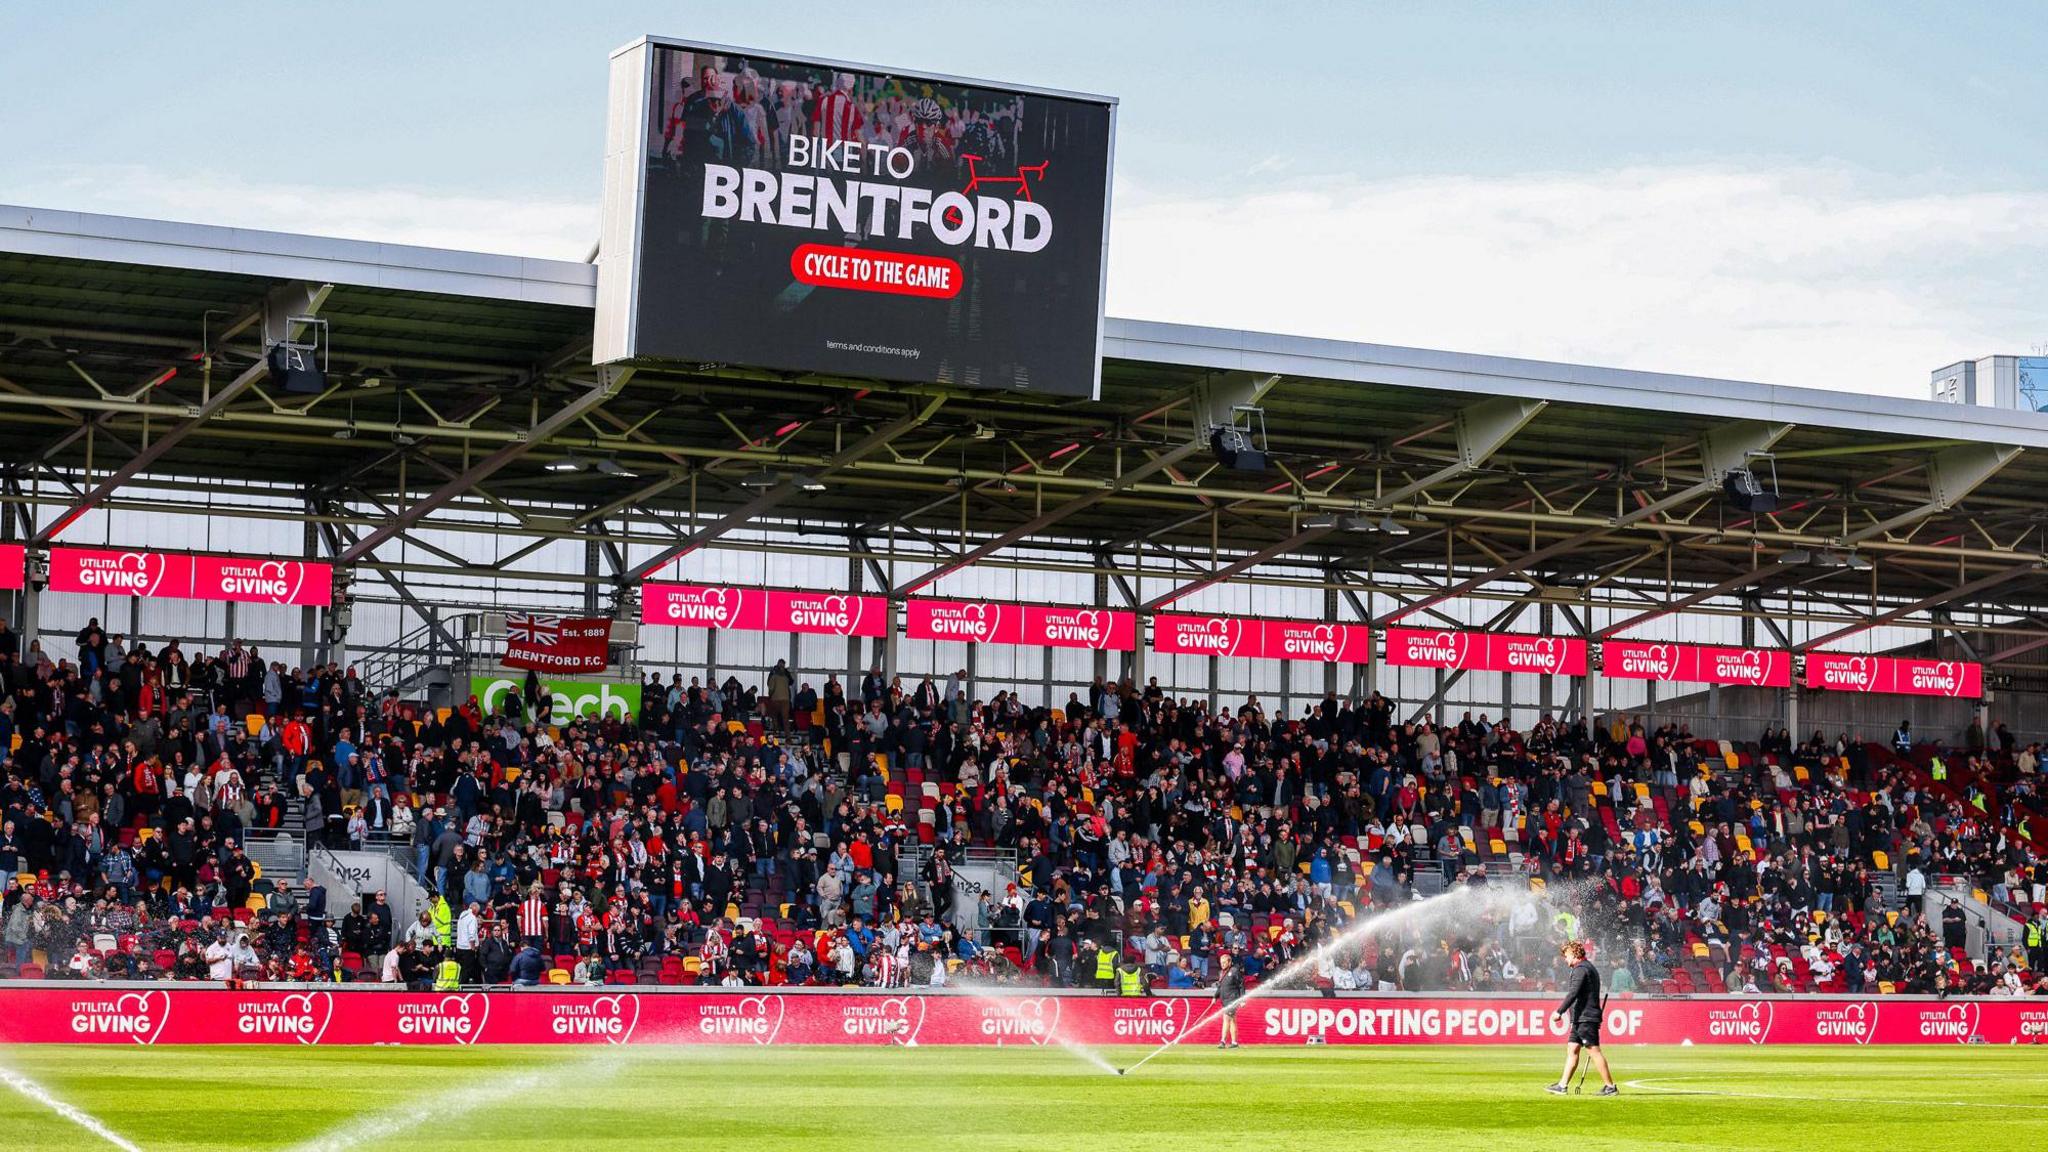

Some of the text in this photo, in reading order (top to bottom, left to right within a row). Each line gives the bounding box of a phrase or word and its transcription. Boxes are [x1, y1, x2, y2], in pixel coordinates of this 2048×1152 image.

[788, 134, 914, 179] BIKE TO
[701, 163, 1053, 253] BRENTFORD
[804, 253, 950, 289] CYCLE TO THE GAME
[849, 343, 862, 351] and
[863, 345, 900, 355] conditions
[901, 348, 920, 359] apply
[80, 558, 116, 569] UTILITA
[221, 566, 257, 577] UTILITA
[80, 570, 148, 588] GIVING
[221, 577, 287, 596] GIVING
[668, 593, 700, 602] UTILITA
[791, 601, 822, 610] UTILITA
[668, 604, 727, 621] GIVING
[791, 611, 848, 627] GIVING
[931, 608, 962, 618] UTILITA
[1046, 615, 1075, 625] UTILITA
[562, 628, 605, 637] Est. 1889
[931, 620, 986, 635] GIVING
[1046, 626, 1099, 641] GIVING
[1177, 624, 1205, 632] UTILITA
[1285, 630, 1312, 638] UTILITA
[1177, 634, 1229, 649] GIVING
[1285, 639, 1334, 654] GIVING
[1408, 638, 1435, 646] UTILITA
[1508, 643, 1534, 651] UTILITA
[509, 649, 603, 666] BRENTFORD F.C.
[1408, 647, 1456, 662] GIVING
[1508, 652, 1555, 667] GIVING
[1623, 650, 1647, 658] UTILITA
[1623, 659, 1668, 673] GIVING
[1717, 664, 1761, 678] GIVING
[1825, 662, 1848, 670] UTILITA
[1913, 667, 1936, 675] UTILITA
[1825, 671, 1867, 684] GIVING
[1913, 676, 1954, 690] GIVING
[336, 867, 371, 881] N124
[957, 881, 981, 894] 123
[72, 1002, 114, 1013] UTILITA
[239, 1003, 279, 1013] UTILITA
[399, 1004, 438, 1014] UTILITA
[553, 1005, 590, 1015] UTILITA
[700, 1006, 736, 1015] UTILITA
[844, 1007, 879, 1016] UTILITA
[982, 1008, 1018, 1016] UTILT
[1114, 1008, 1147, 1017] UTILITA
[1710, 1010, 1737, 1019] UTILITA
[1817, 1011, 1843, 1020] UTILITA
[1920, 1012, 1947, 1020] UTILITA
[2020, 1012, 2046, 1020] UTILITA
[72, 1015, 150, 1033] GIVING
[239, 1015, 314, 1033] GIVING
[398, 1016, 471, 1033] GIVING
[553, 1017, 622, 1033] GIVING
[700, 1018, 768, 1033] GIVING
[982, 1019, 1044, 1034] GIVING
[1114, 1020, 1174, 1034] GIVING
[1265, 1008, 1440, 1036] SUPPORTING
[1446, 1009, 1544, 1036] PEOPLE
[1607, 1009, 1643, 1036] OF
[1710, 1021, 1761, 1035] GIVING
[1817, 1022, 1866, 1035] GIVING
[1920, 1022, 1968, 1035] GIVING
